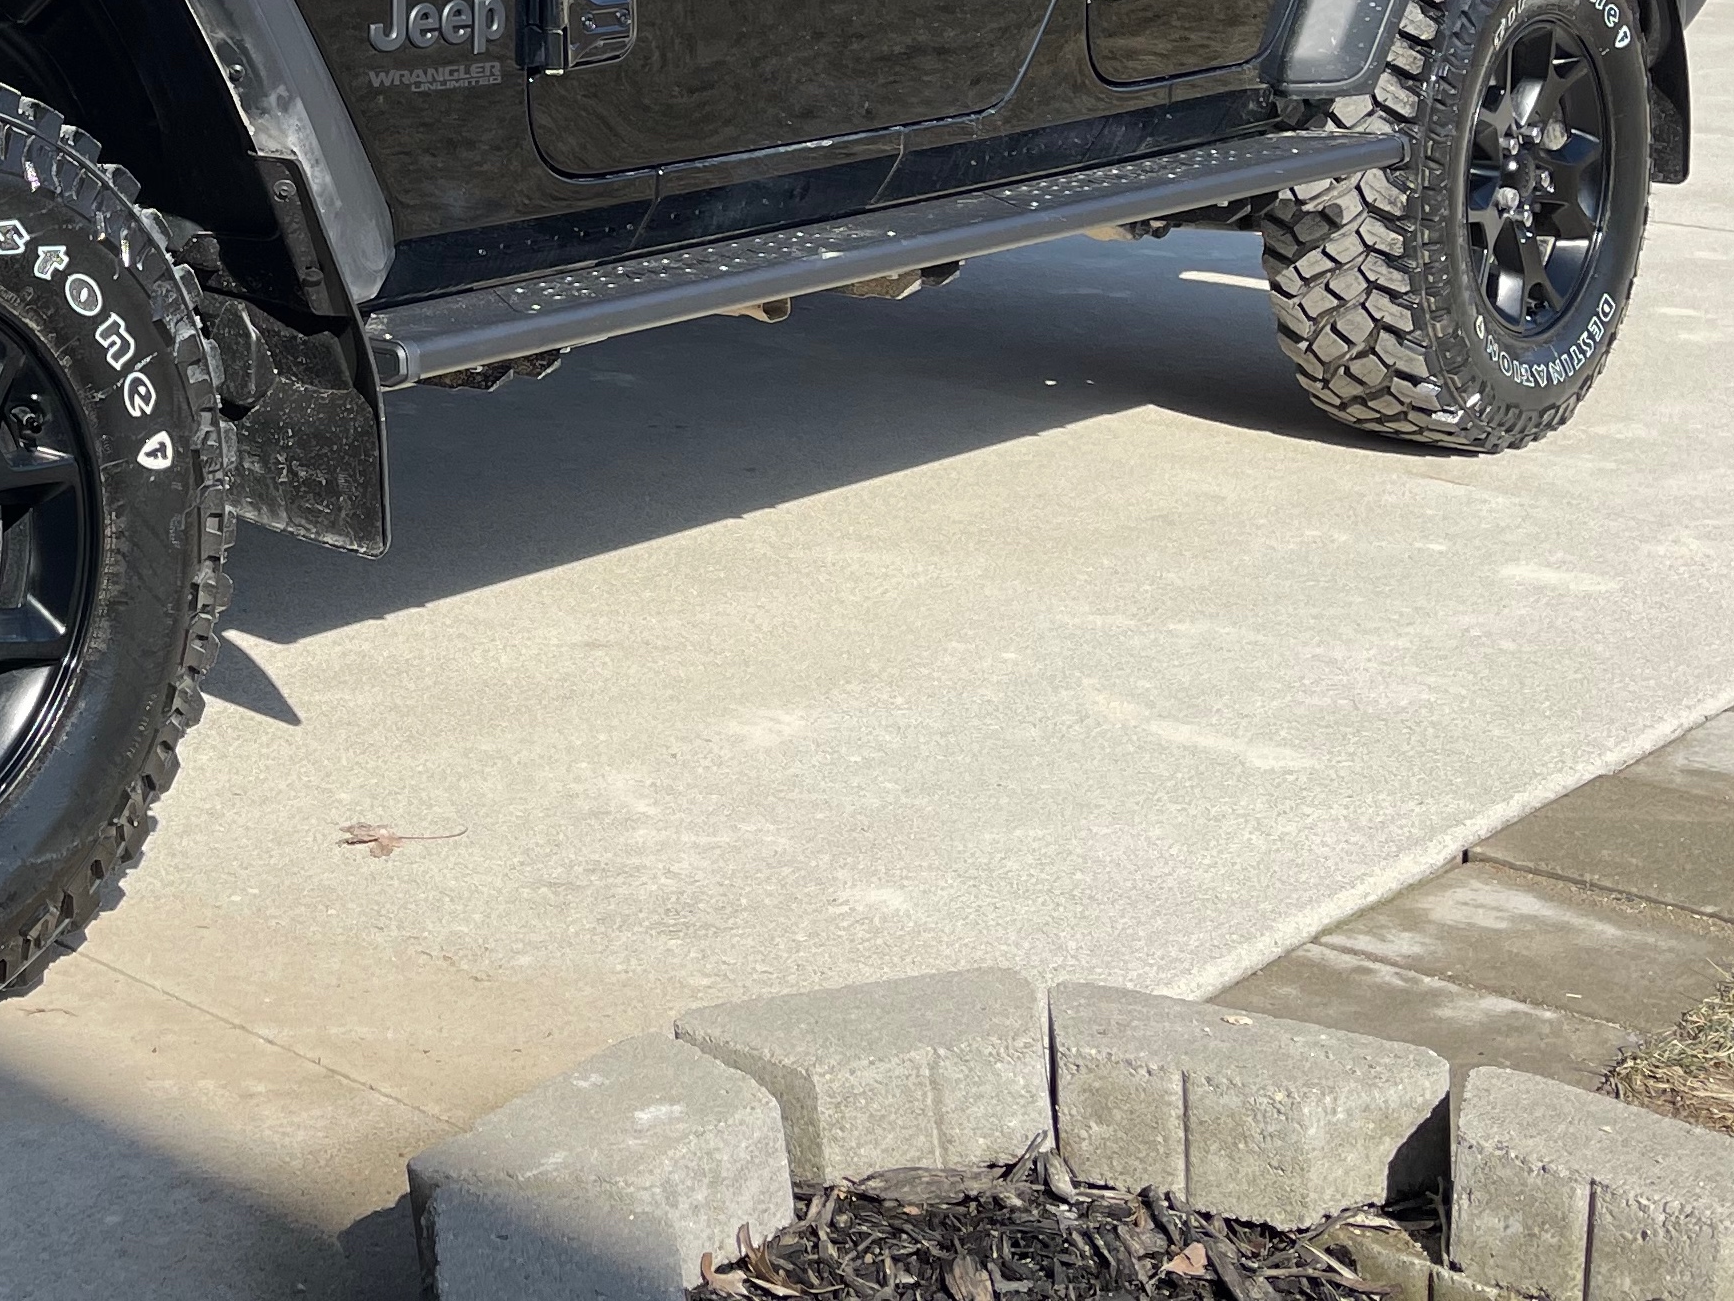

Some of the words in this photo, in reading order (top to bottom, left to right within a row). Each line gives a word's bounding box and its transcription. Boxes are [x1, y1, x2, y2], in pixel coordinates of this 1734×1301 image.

[368, 61, 502, 88] WRANGLER
[410, 74, 502, 92] UNLIMITED
[1486, 292, 1617, 388] DESTINATION
